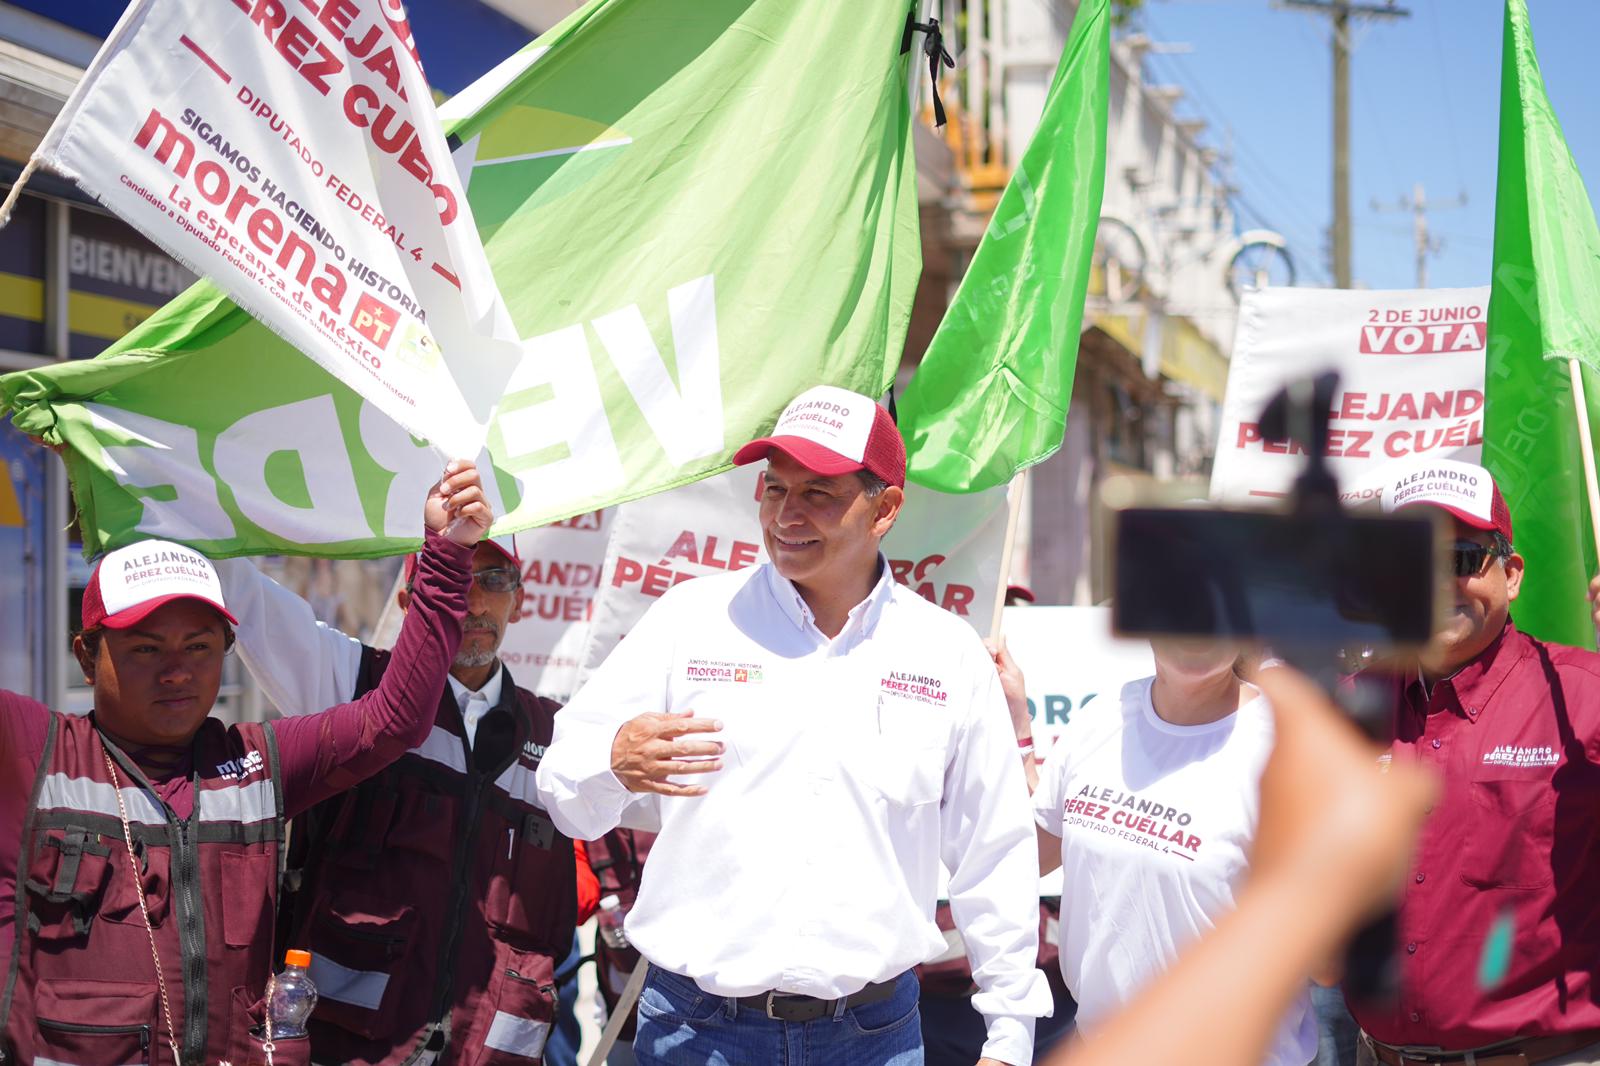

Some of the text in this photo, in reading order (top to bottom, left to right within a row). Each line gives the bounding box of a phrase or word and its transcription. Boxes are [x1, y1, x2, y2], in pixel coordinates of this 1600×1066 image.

[236, 86, 323, 177] DIPUTADO
[325, 174, 405, 250] FEDERAL
[410, 247, 423, 261] 4
[134, 107, 348, 315] morena
[180, 108, 261, 183] SIGAMOS
[261, 178, 345, 261] HACIENDO
[347, 257, 427, 325] HISTORIA
[120, 174, 167, 212] Candidato
[176, 215, 221, 252] Diputado
[222, 251, 257, 281] Federal
[70, 234, 184, 293] BIENVEN
[168, 184, 192, 212] La
[197, 209, 286, 291] esperanza
[292, 291, 313, 314] de
[319, 311, 381, 369] México
[355, 309, 392, 344] PT
[1369, 306, 1481, 323] 2 DE JUNIO
[1363, 323, 1482, 353] VOTA
[785, 401, 850, 417] ALEJANDRO
[800, 412, 844, 430] CUÉLLAR
[1394, 484, 1424, 504] PÉREZ
[1427, 481, 1477, 499] CUÉLLAR
[1395, 469, 1478, 491] ALEJANDRO
[123, 551, 206, 572] ALEJANDRO
[125, 565, 210, 584] PÉREZ CUÉLLAR
[687, 666, 732, 677] morena
[890, 670, 941, 688] ALEJANDRO
[881, 678, 947, 701] PÉREZ CUÉLLAR
[1494, 746, 1552, 755] ALEJANDRO
[1079, 784, 1191, 826] ALEJANDRO
[1068, 817, 1116, 836] DIPUTADO
[1118, 830, 1160, 851] FEDERAL
[1112, 810, 1202, 852] CUÉLLAR
